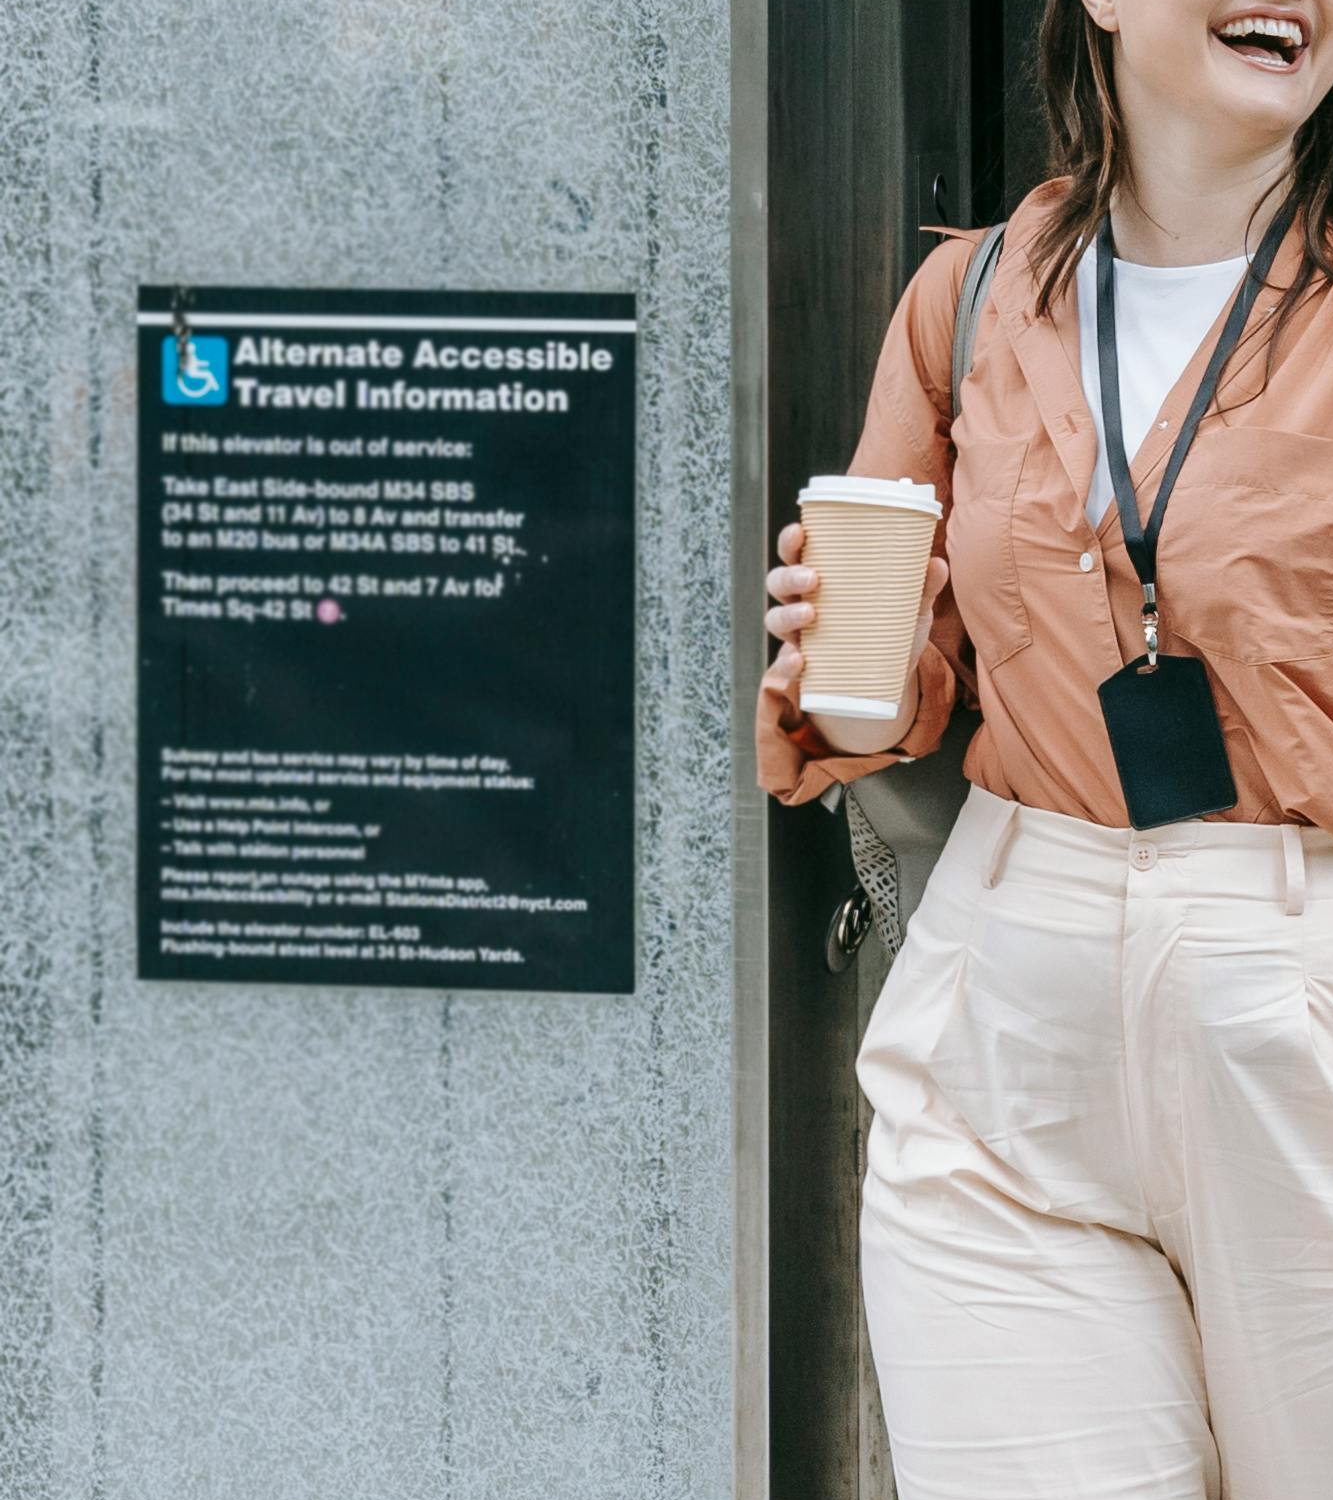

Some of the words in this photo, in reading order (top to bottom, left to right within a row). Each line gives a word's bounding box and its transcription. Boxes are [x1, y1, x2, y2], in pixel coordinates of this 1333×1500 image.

[234, 337, 403, 367] Alternate
[414, 339, 612, 371] Accessible
[234, 378, 345, 408] Travel
[357, 380, 568, 412] Information
[162, 433, 178, 451] If
[180, 434, 219, 453] this
[222, 435, 302, 455] elevator
[307, 436, 325, 455] is
[329, 437, 362, 456] out
[367, 437, 388, 456] of
[392, 438, 472, 458] service:
[163, 476, 210, 496] Take
[214, 477, 258, 497] East
[262, 478, 380, 499] Side-bound
[384, 481, 426, 500] M34
[430, 481, 474, 501] SBS
[162, 502, 193, 524] (34
[198, 502, 219, 522] St
[224, 505, 262, 523] and
[267, 505, 286, 522] 11
[292, 505, 326, 527] Av)
[328, 507, 350, 525] to
[370, 507, 397, 525] Av
[402, 508, 440, 527] and
[444, 508, 524, 528] transfer
[162, 530, 183, 547] to
[216, 529, 258, 549] M20
[262, 531, 300, 550] bus
[304, 535, 326, 550] or
[330, 532, 386, 552] M34A
[392, 532, 436, 553] SBS
[440, 535, 460, 553] to
[464, 535, 486, 553] 41
[162, 571, 212, 591] Then
[216, 574, 300, 596] proceed
[303, 576, 324, 594] to
[328, 575, 352, 595] 42
[356, 575, 378, 595] St
[382, 577, 422, 596] and
[443, 577, 470, 596] Av
[162, 597, 222, 617] Times
[290, 600, 312, 620] St
